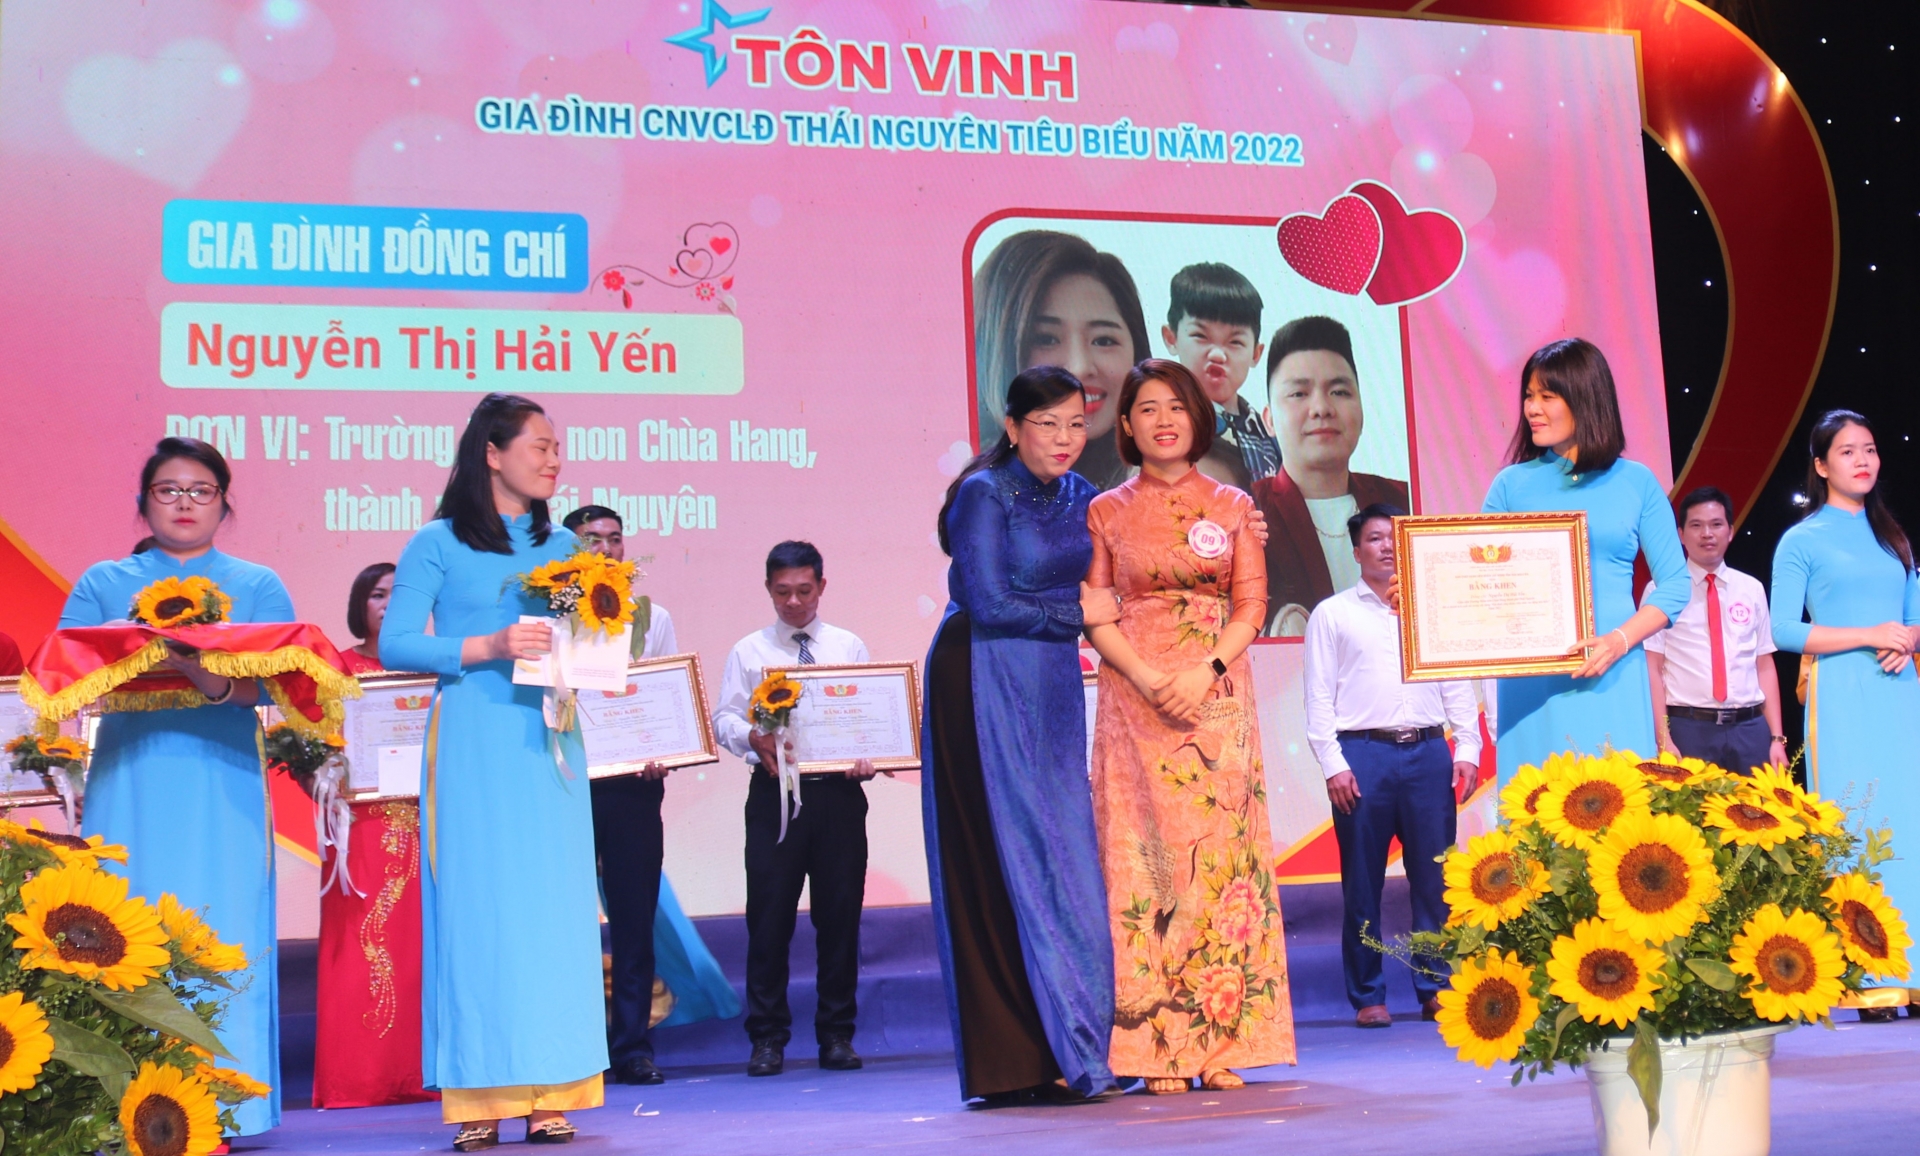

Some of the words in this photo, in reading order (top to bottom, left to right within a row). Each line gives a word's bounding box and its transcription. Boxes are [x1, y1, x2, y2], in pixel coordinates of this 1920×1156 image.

[734, 29, 890, 92] TÔN
[904, 46, 1076, 99] VINH
[478, 100, 539, 131] GIA
[547, 97, 632, 135] ĐÌNH
[642, 108, 775, 142] CNVCLĐ
[785, 111, 861, 146] THÁI
[872, 116, 998, 151] NGUYÊN
[1006, 119, 1074, 154] TIÊU
[1082, 119, 1149, 158] BIỂU
[1158, 125, 1225, 160] NĂM
[1233, 134, 1301, 164] 2022
[187, 220, 259, 270] GIA
[270, 215, 371, 273] ĐÌNH
[382, 213, 490, 277] ĐỒNG
[504, 223, 567, 279] CHÍ
[187, 320, 382, 380] Nguyễn
[399, 325, 477, 381] Thị
[495, 325, 572, 373] Hải
[588, 327, 678, 374] Yến
[261, 416, 310, 467] VỊ:
[324, 416, 455, 468] Trường
[566, 426, 627, 462] non
[639, 418, 718, 462] Chùa
[730, 420, 818, 468] Hang,
[324, 485, 424, 532] thành
[1201, 534, 1216, 546] 09
